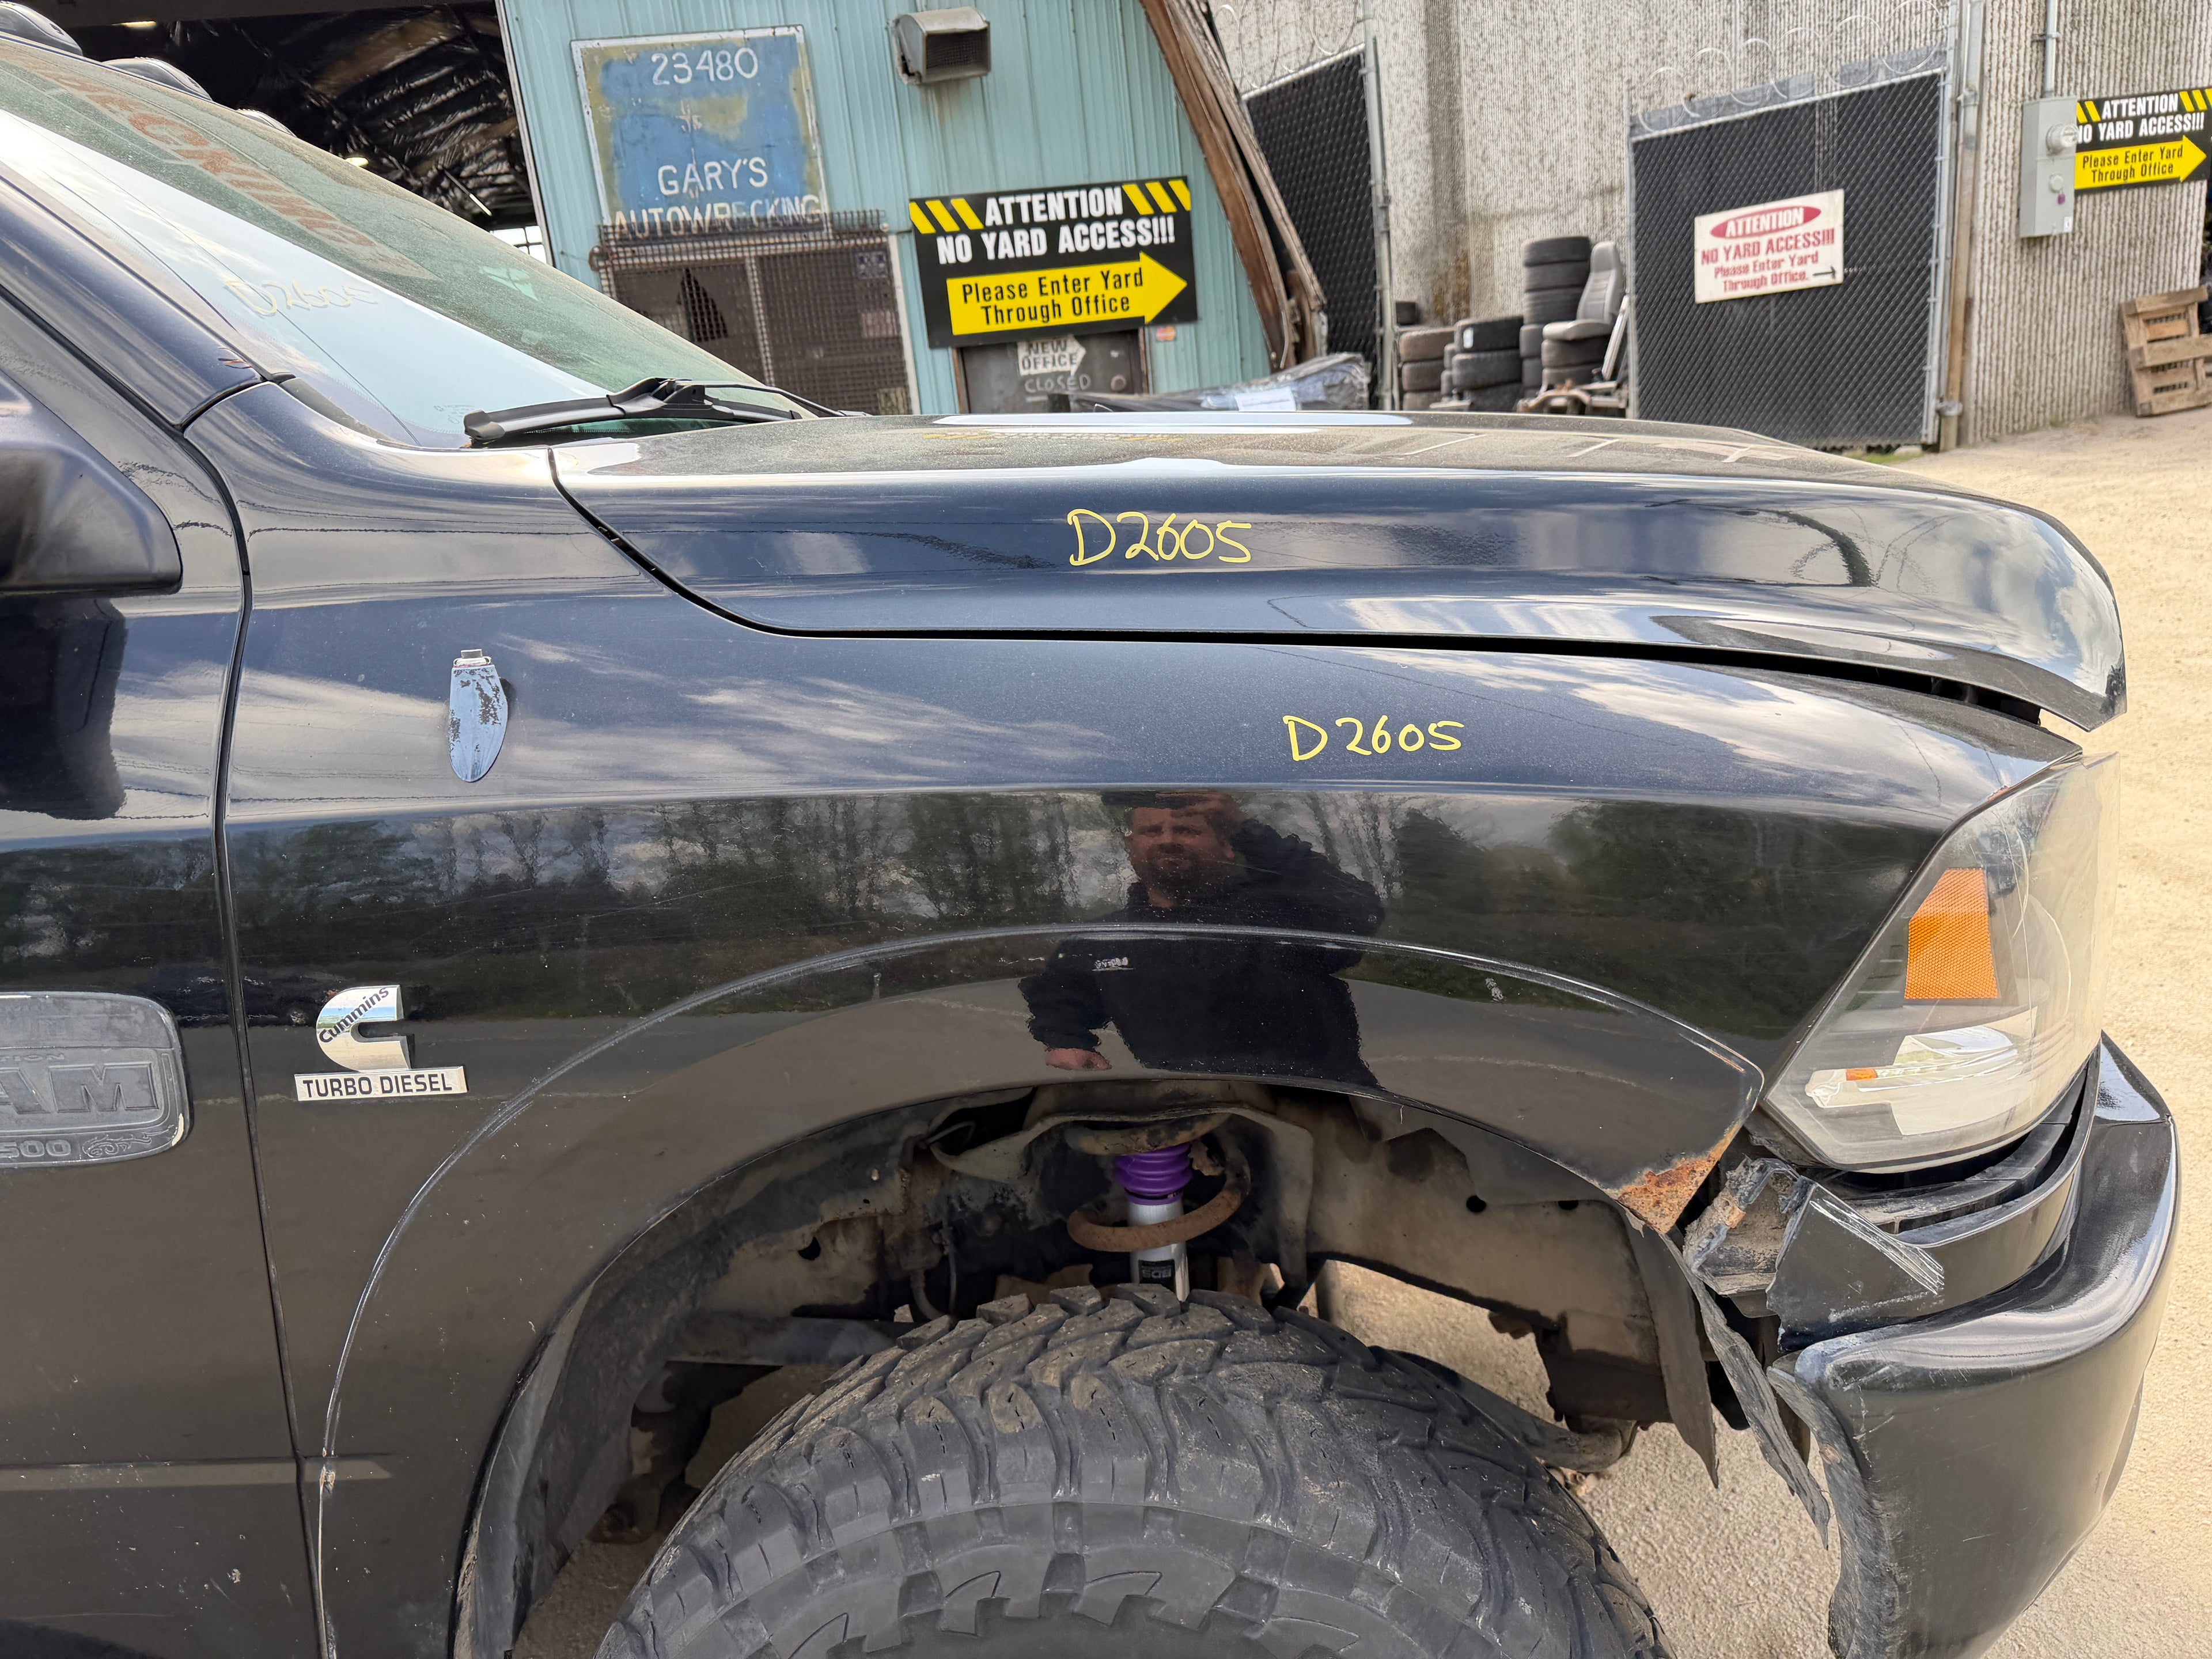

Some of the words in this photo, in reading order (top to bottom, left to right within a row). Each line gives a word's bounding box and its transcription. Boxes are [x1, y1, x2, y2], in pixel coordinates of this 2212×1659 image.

[652, 47, 759, 86] 23480
[2102, 93, 2179, 120] ATTENTION
[2098, 120, 2134, 141] YARD
[2139, 112, 2205, 138] ACCESS!!!
[2082, 153, 2118, 168] Please
[2124, 149, 2154, 164] Enter
[2160, 145, 2183, 160] Yard
[658, 157, 768, 196] GARY'S
[2091, 167, 2135, 183] Through
[2141, 162, 2174, 176] Office
[614, 194, 822, 240] AUTOWRECKING
[984, 187, 1124, 226] ATTENTION
[1726, 207, 1804, 237] ATTENTION
[937, 234, 973, 265] NO
[980, 228, 1047, 260] YARD
[1058, 216, 1176, 253] ACCESS!!!
[1700, 249, 1718, 266] NO
[1724, 242, 1760, 261] YARD
[1766, 229, 1834, 255] ACCESS!!!
[1715, 263, 1749, 278] Please
[1753, 259, 1784, 272] Enter
[1789, 252, 1818, 267] Yard
[222, 279, 378, 317] D2605
[962, 281, 1028, 304] Please
[1037, 275, 1090, 297] Enter
[1100, 267, 1143, 290] Yard
[1724, 276, 1767, 291] Through
[980, 298, 1062, 325] Through
[1072, 295, 1130, 316] Office
[1021, 354, 1078, 370] OFFICE
[1027, 340, 1067, 354] NEW
[1025, 373, 1092, 393] CLOSED
[1067, 508, 1252, 566] D2605
[1282, 715, 1465, 762] D2605
[319, 986, 389, 1043] Cummins
[303, 1077, 373, 1098] TURBO
[380, 1073, 452, 1094] DIESEL
